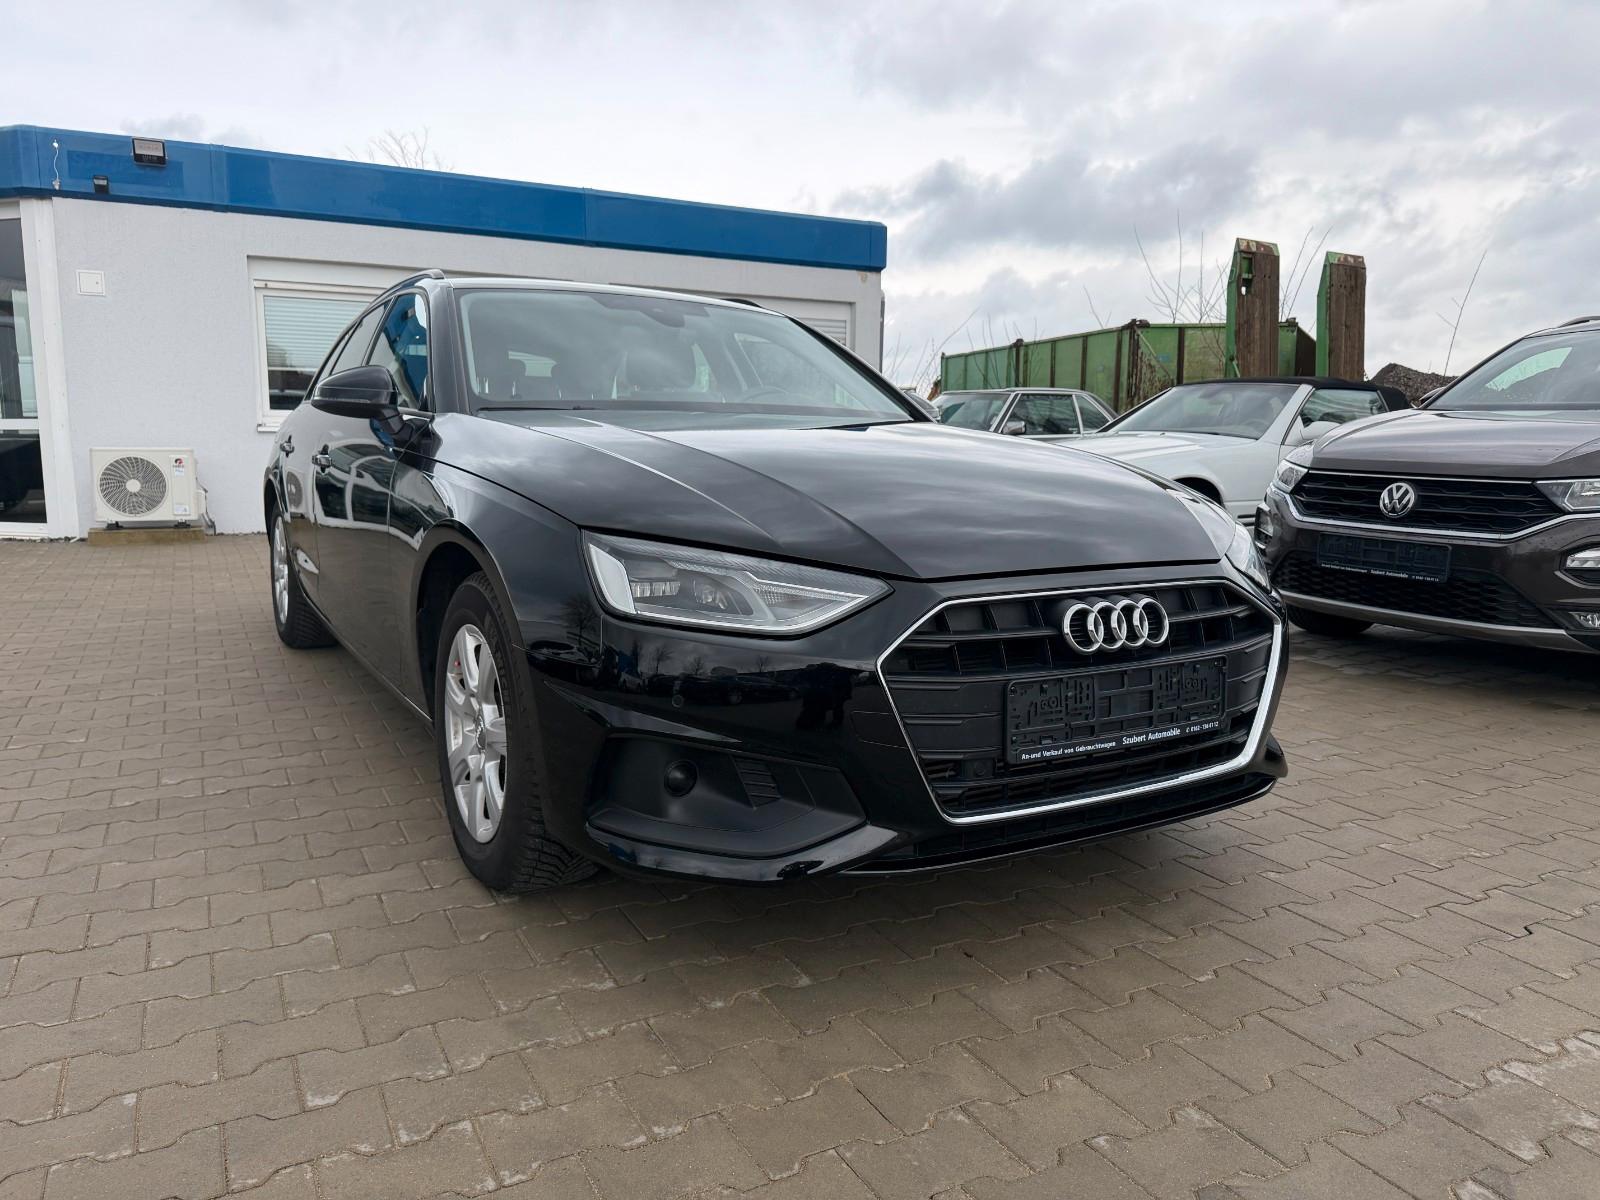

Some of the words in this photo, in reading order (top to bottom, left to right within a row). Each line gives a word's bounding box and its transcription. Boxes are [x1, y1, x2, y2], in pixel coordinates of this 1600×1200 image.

[1042, 748, 1063, 758] Verkauf
[1075, 741, 1116, 753] Gebrauchtwagen
[1122, 734, 1147, 745] Szubert
[1147, 727, 1181, 740] Automobile
